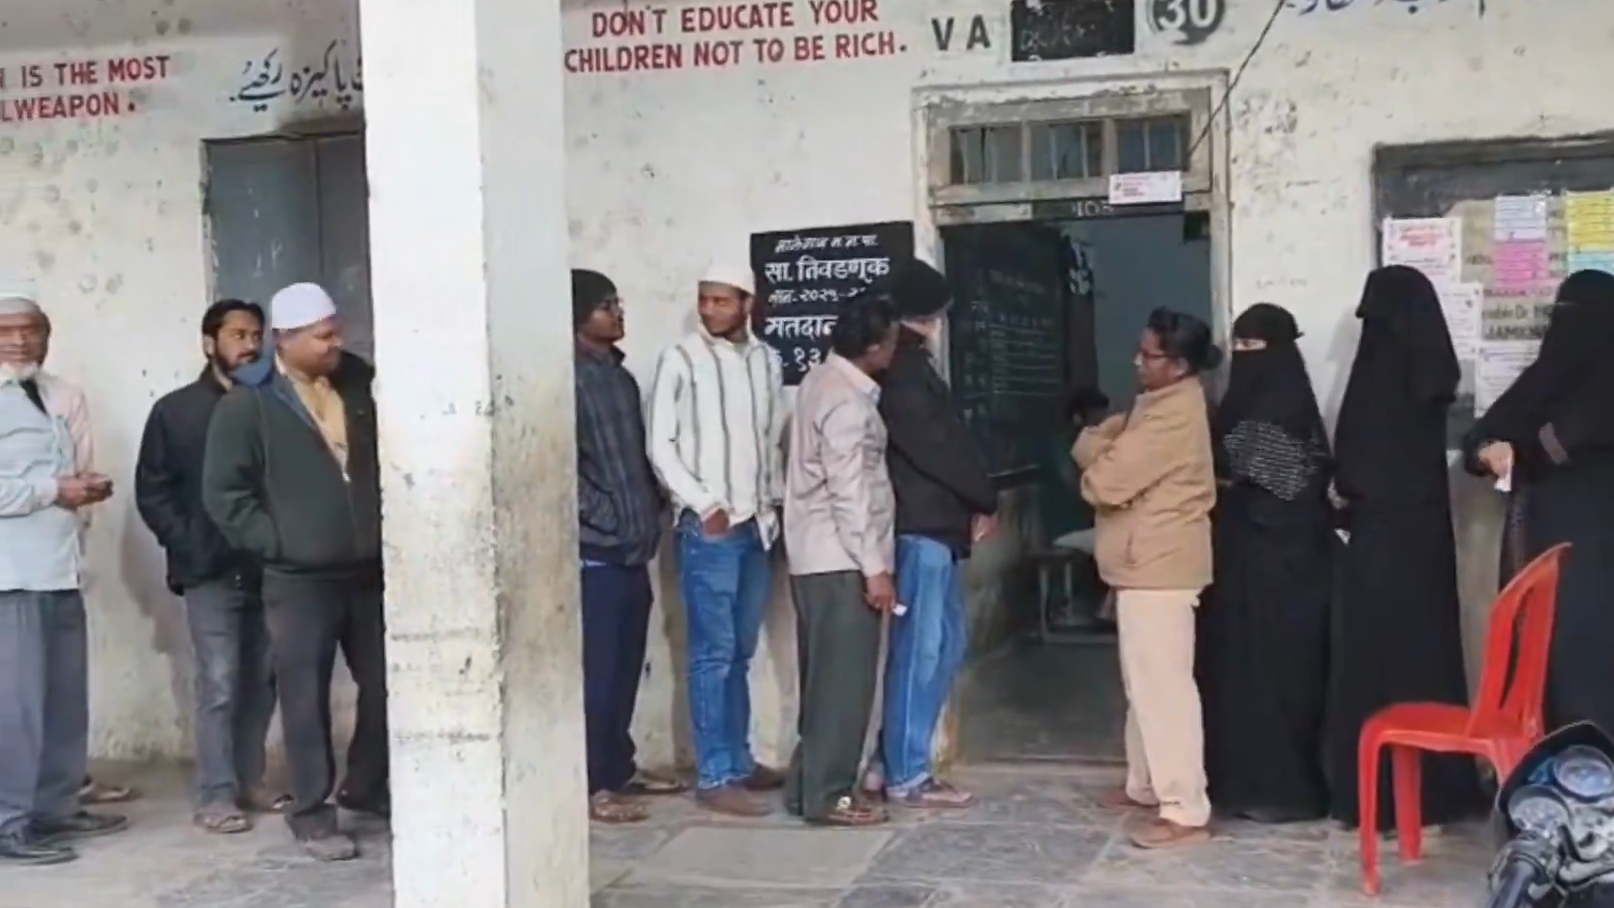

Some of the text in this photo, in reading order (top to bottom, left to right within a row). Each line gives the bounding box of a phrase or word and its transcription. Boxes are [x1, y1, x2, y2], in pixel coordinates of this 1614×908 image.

[592, 0, 879, 37] DON'T EDUCATE YOUR
[1158, 0, 1217, 28] 30
[564, 44, 682, 73] CHILDREN
[694, 40, 744, 67] NOT
[753, 37, 785, 62] TO
[794, 35, 825, 61] BE
[21, 65, 43, 88] IS
[54, 61, 98, 86] THE
[108, 56, 170, 82] MOST
